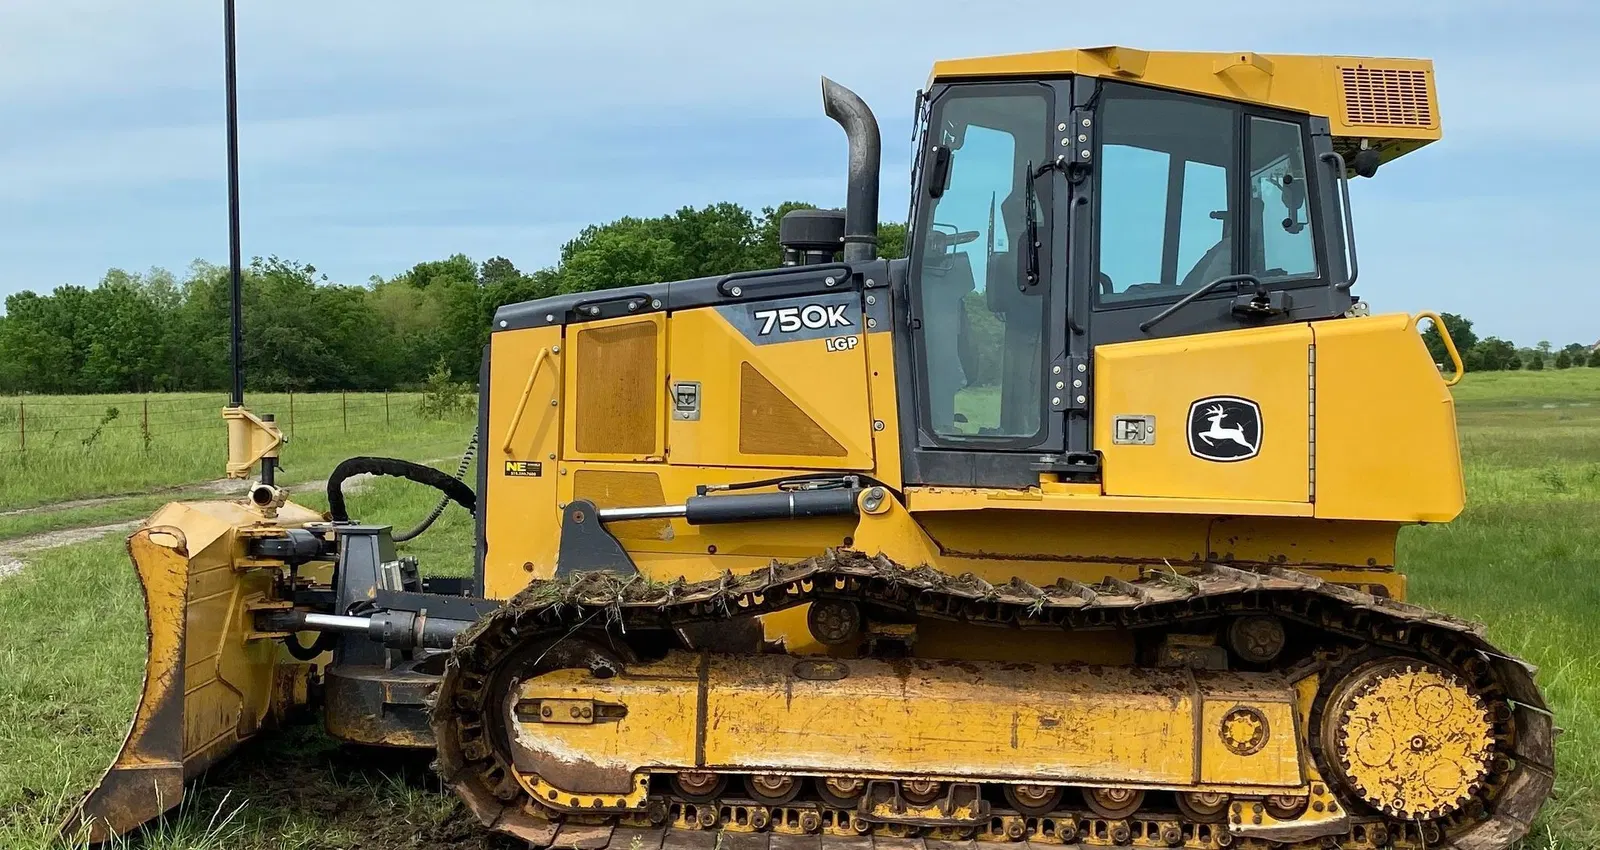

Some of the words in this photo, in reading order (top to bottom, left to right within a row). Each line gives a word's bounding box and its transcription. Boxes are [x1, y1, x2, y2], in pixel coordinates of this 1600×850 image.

[754, 304, 854, 336] 750K
[826, 336, 858, 352] LGP
[506, 462, 527, 472] NE
